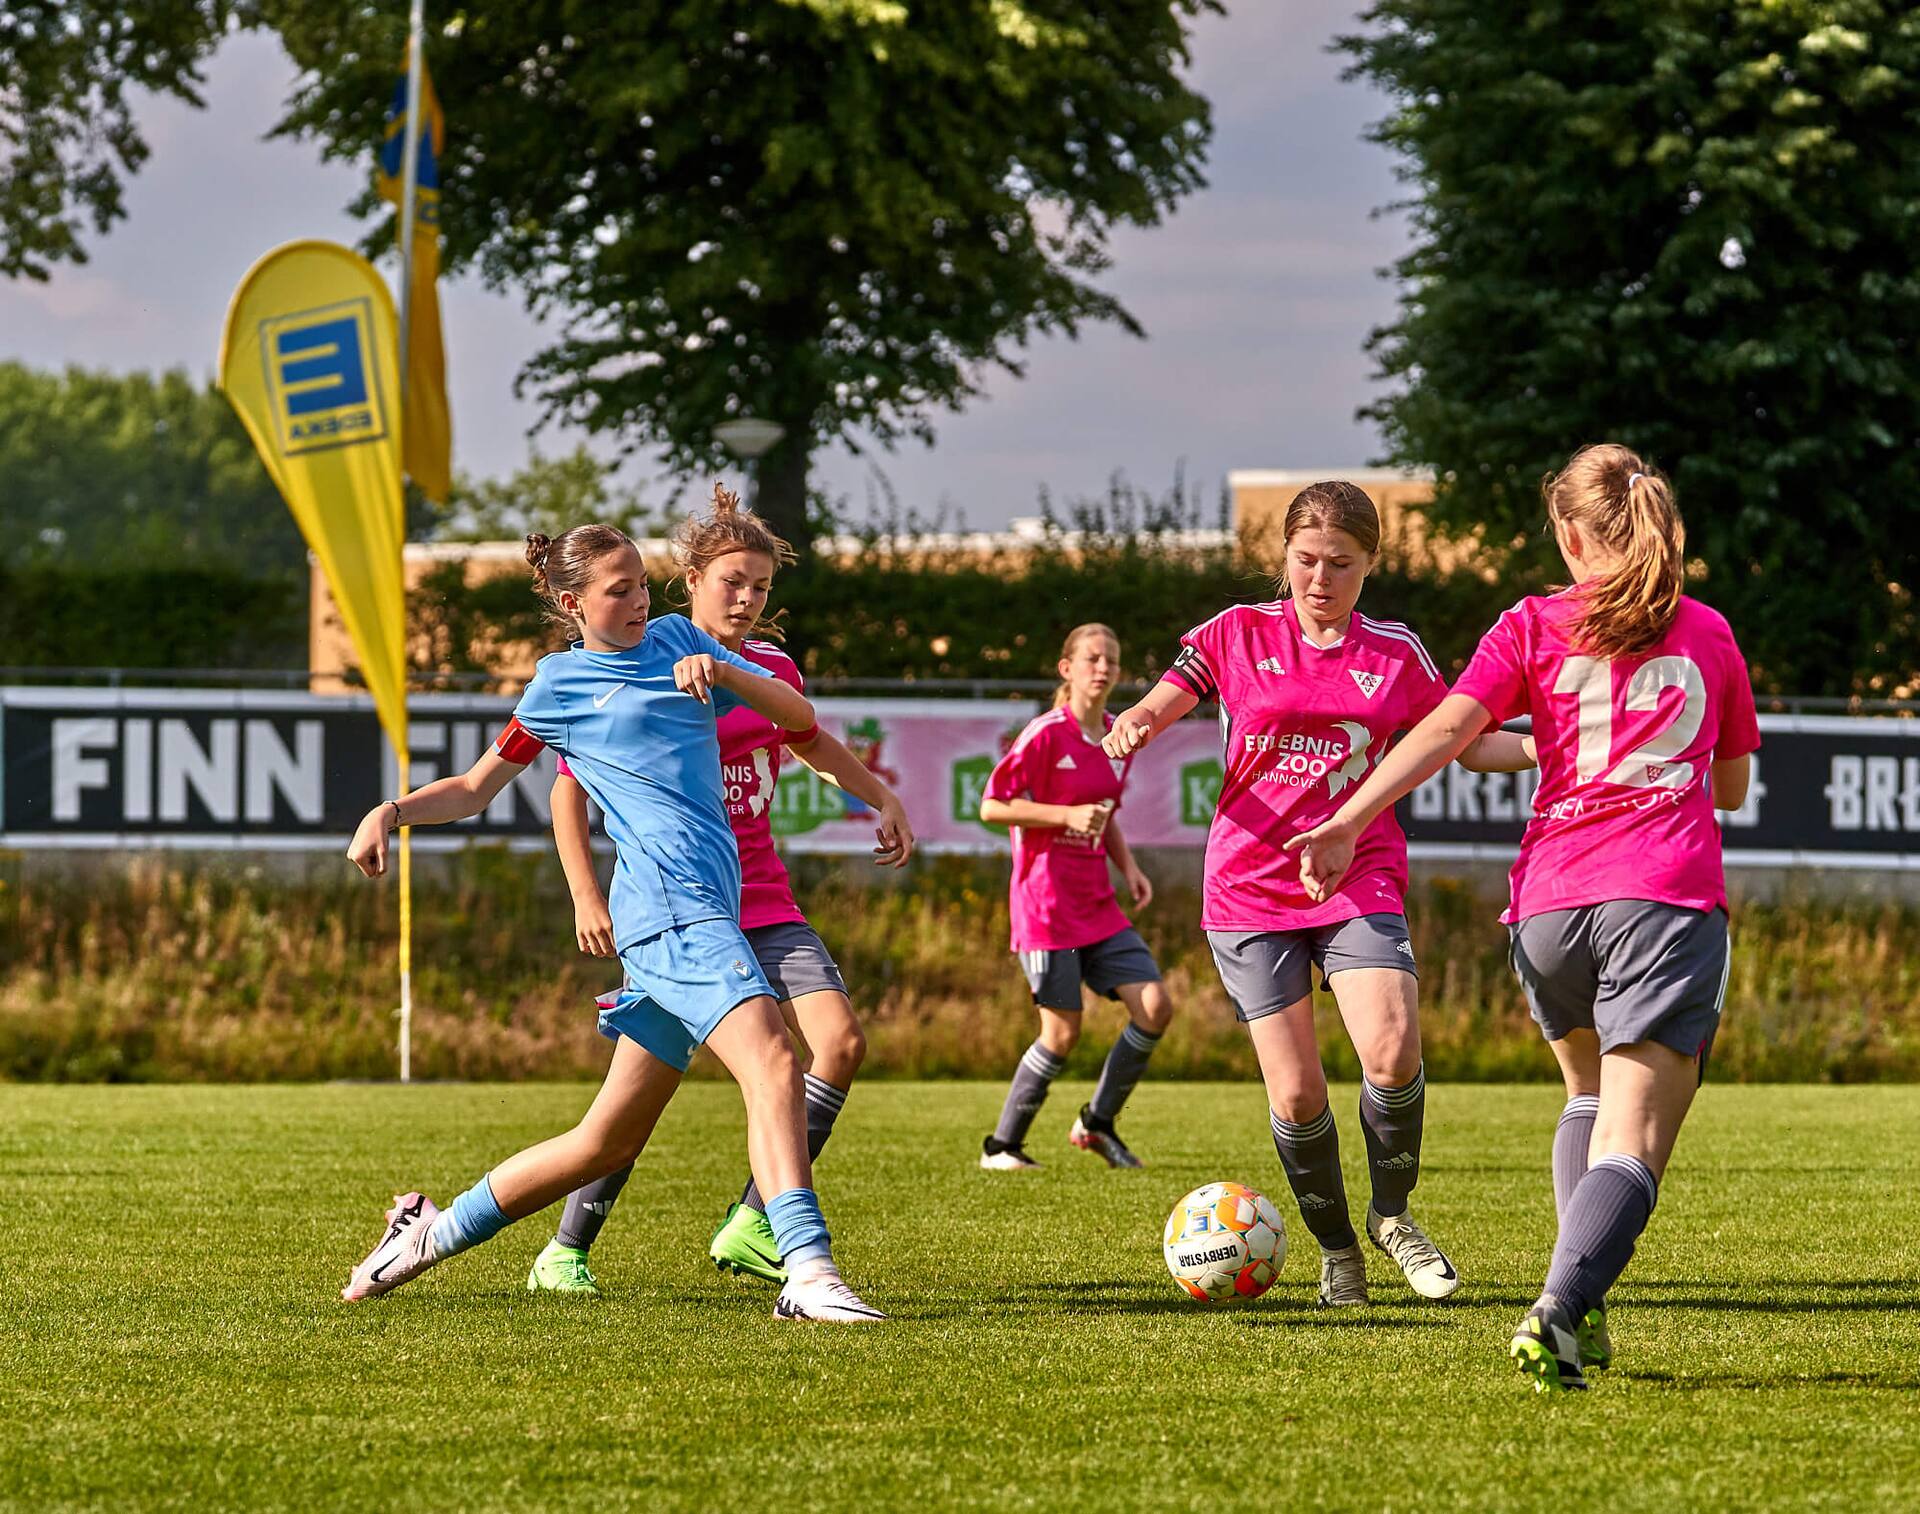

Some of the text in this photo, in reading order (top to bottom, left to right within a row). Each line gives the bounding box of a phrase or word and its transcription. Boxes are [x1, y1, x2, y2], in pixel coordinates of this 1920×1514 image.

[1552, 655, 1707, 789] 12
[1244, 734, 1344, 760] ERLEBNIS
[50, 718, 324, 823] FINN
[1275, 752, 1327, 777] ZOO
[1252, 770, 1319, 789] HANNOVE
[1179, 1244, 1238, 1267] DERBYSTAR
